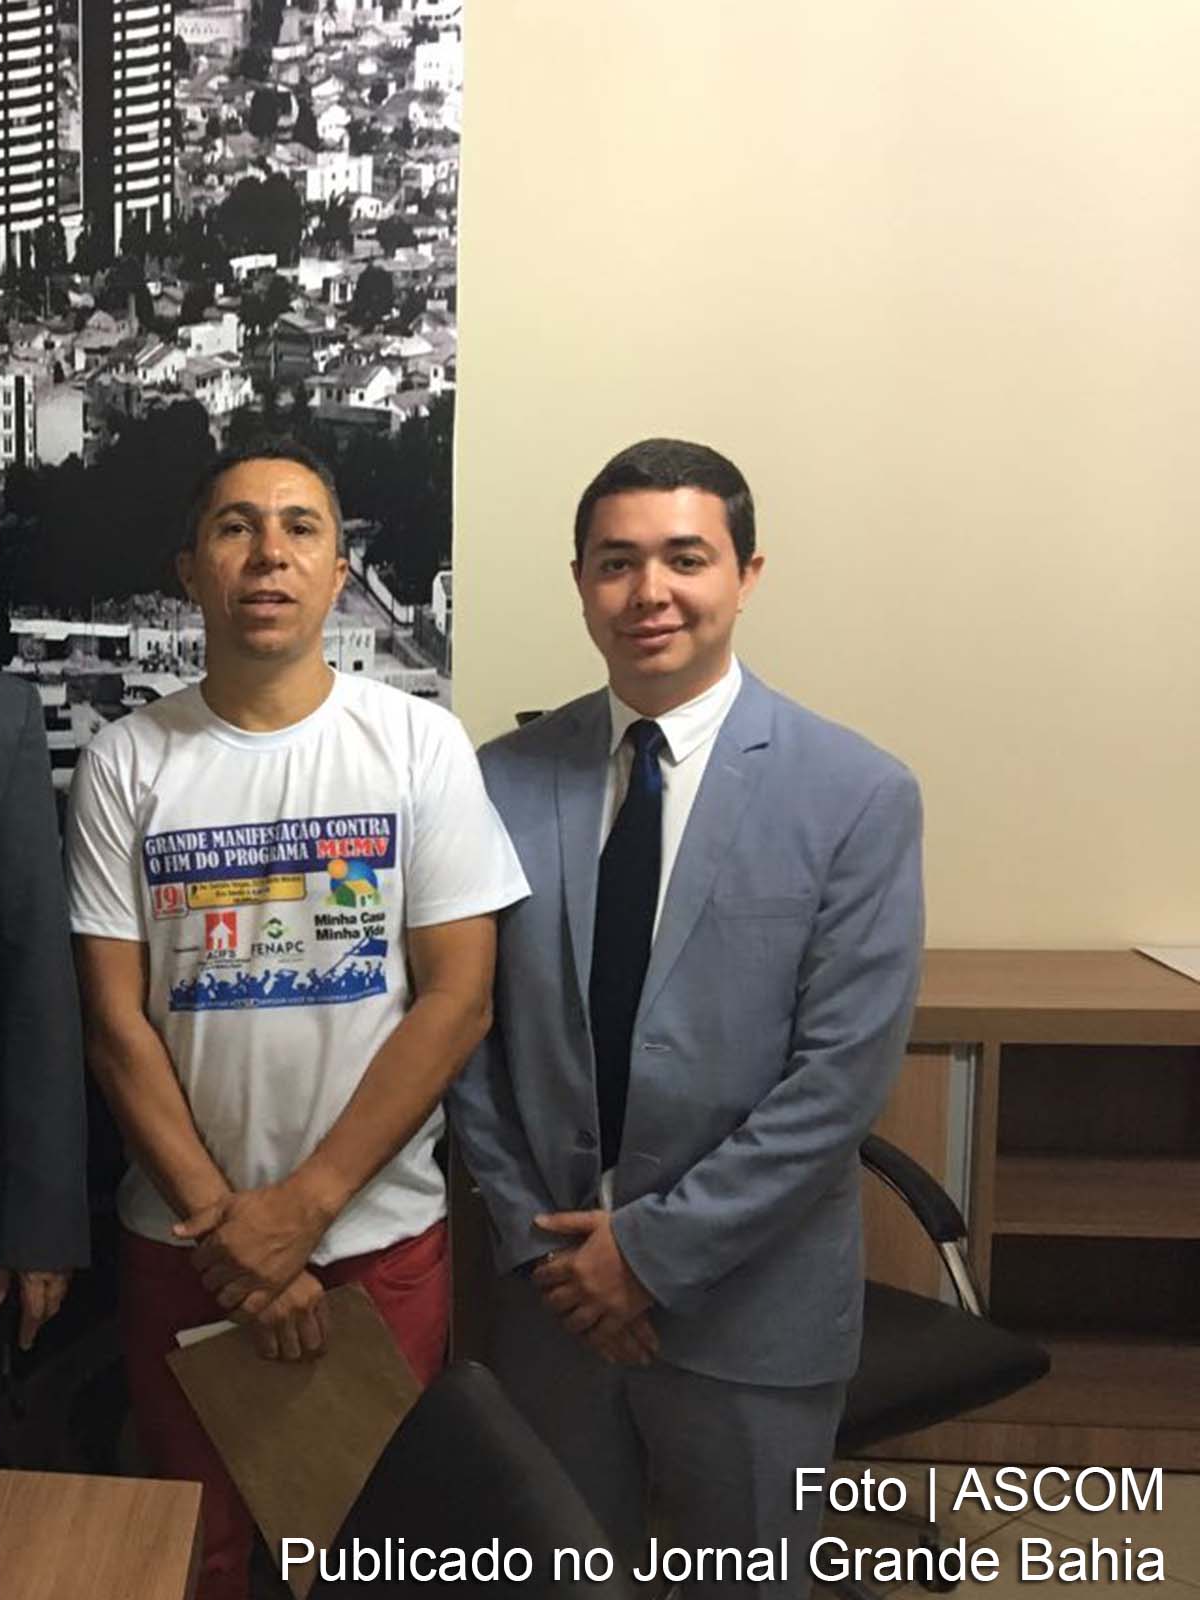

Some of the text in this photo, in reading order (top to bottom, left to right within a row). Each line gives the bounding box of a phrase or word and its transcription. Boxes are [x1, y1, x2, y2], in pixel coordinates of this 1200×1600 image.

[144, 831, 208, 856] GRANDE
[326, 817, 390, 838] CONTRA
[149, 837, 389, 874] O FIM DO PROGRAMA MCMV
[314, 912, 357, 926] Minha
[316, 927, 360, 941] Minha
[250, 940, 305, 956] FENAPC
